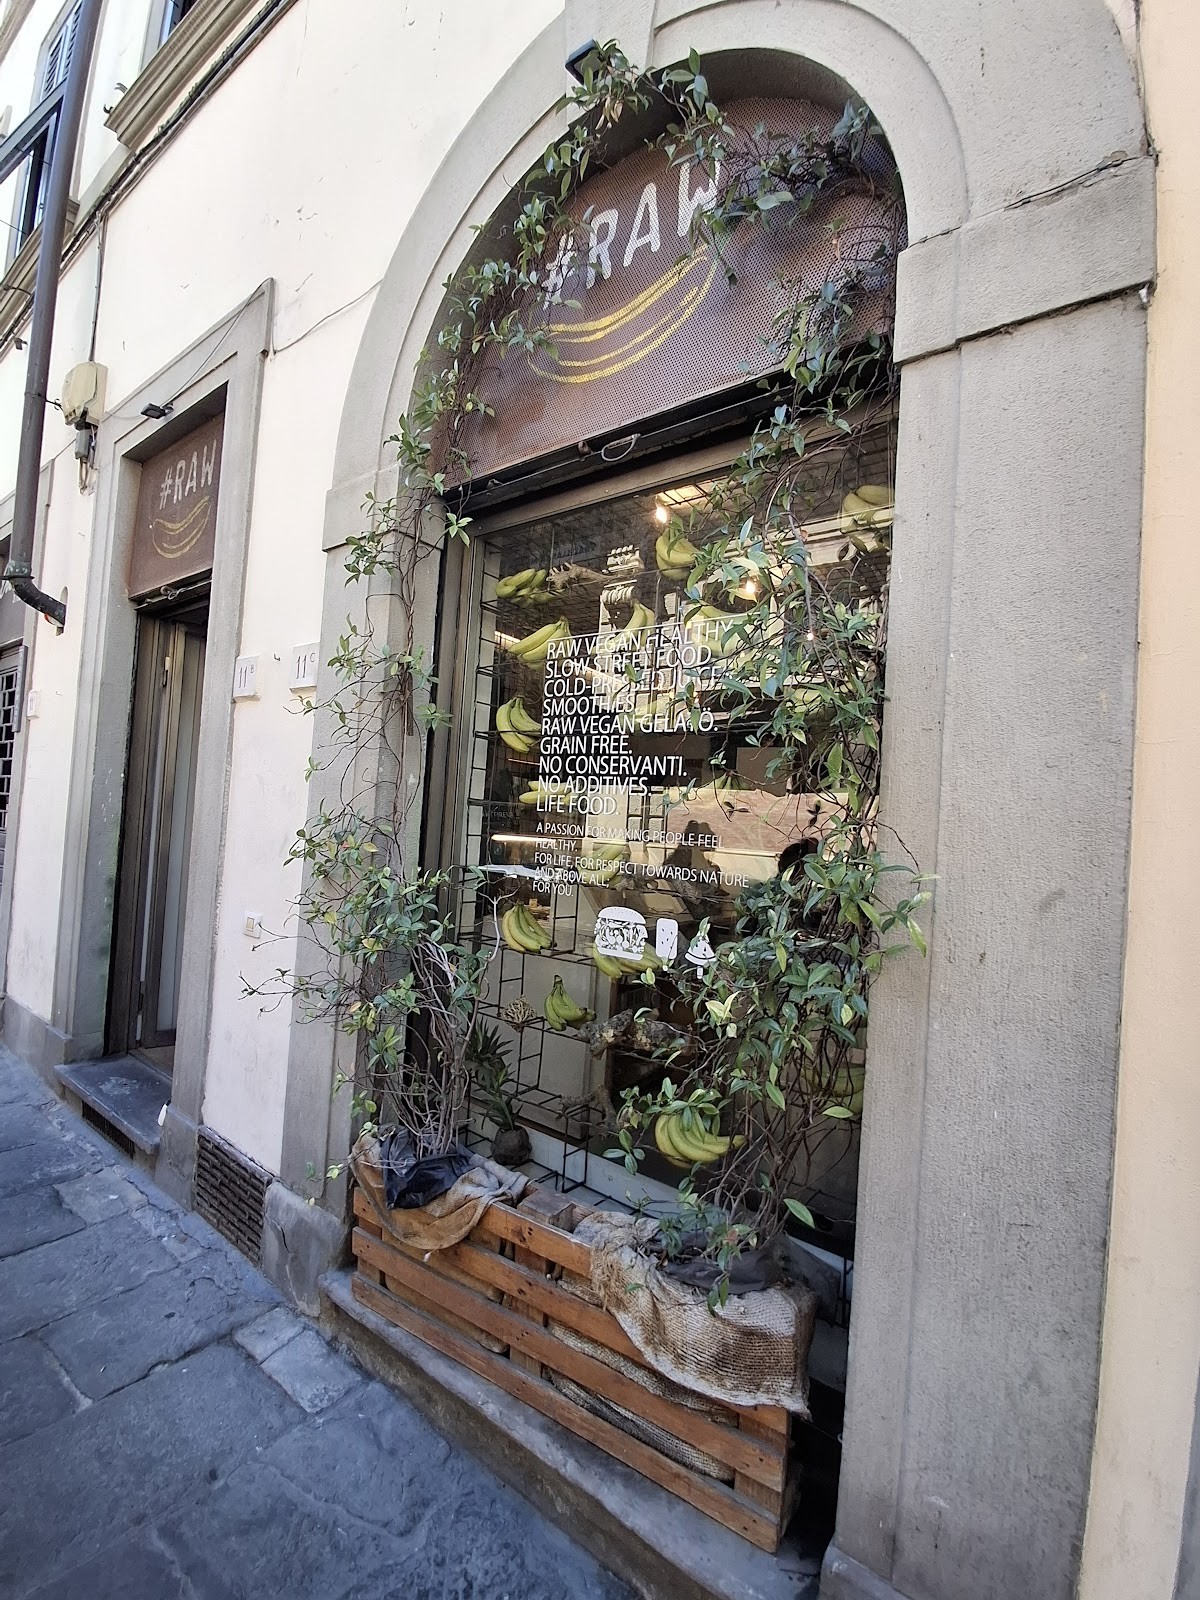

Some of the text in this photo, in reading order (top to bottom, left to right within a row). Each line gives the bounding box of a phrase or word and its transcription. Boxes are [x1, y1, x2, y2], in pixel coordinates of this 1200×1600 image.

[541, 160, 721, 310] #RAW
[159, 439, 217, 510] #RAW
[546, 638, 582, 660] RAW
[585, 630, 641, 656] VEGAN
[545, 645, 712, 679] SLOW STREET FOOD
[541, 716, 577, 736] RAW
[580, 714, 635, 735] VEGAN
[540, 735, 633, 754] GRAIN FREE.
[539, 755, 688, 777] NO CONSERVANTI.
[538, 775, 652, 797] NO ADDITIVES.
[536, 794, 620, 815] LIFE FOOD.
[535, 839, 578, 852] HEALTHY.
[536, 822, 725, 848] A PASSION FOR MAKING PEOPLE FEEL
[534, 852, 750, 888] FOR LIFE, FOR RESPECT TOWARDS NATURE
[535, 866, 555, 879] AND
[556, 869, 587, 884] ABOVE
[532, 880, 574, 897] FOR YOU.
